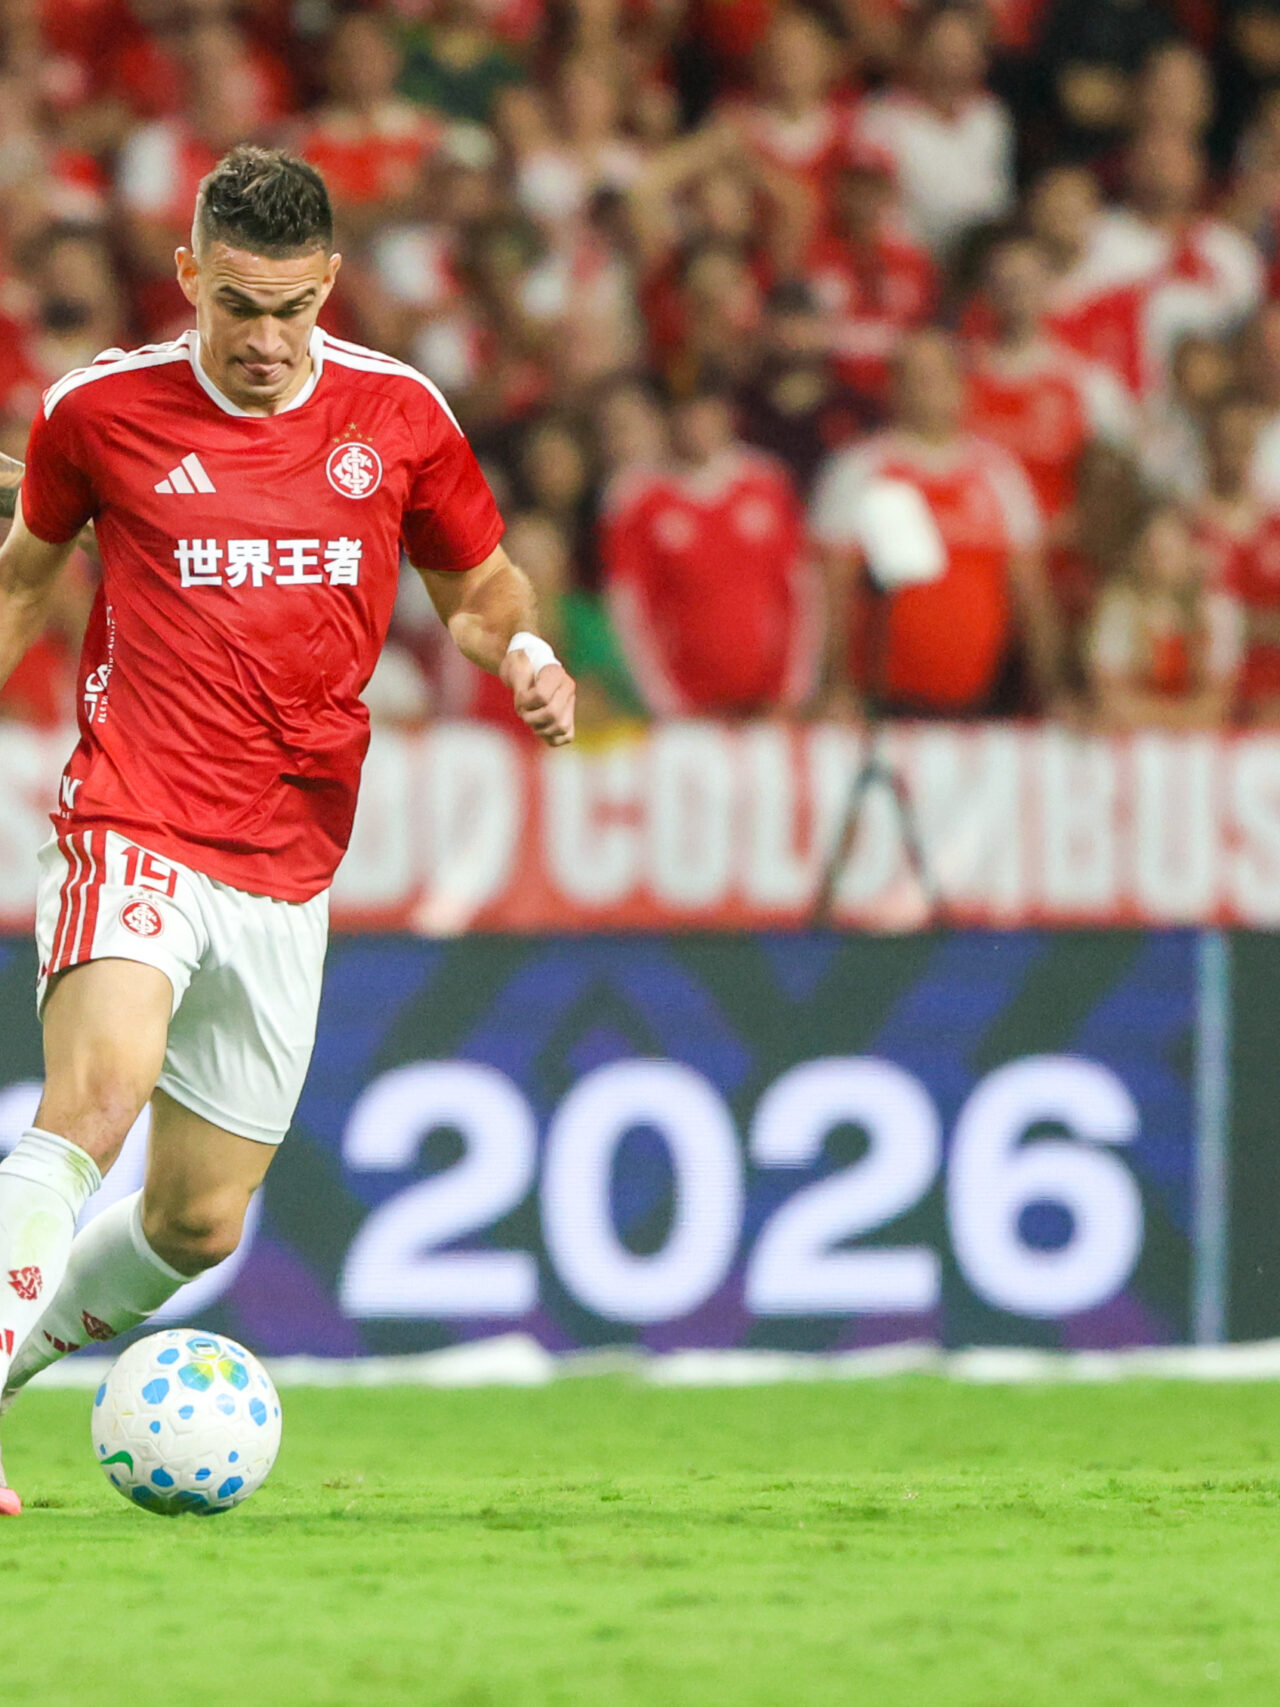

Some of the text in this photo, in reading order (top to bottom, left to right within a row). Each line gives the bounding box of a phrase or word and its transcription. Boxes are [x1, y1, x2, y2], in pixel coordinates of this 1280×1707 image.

[173, 536, 363, 588] 世界王者
[120, 845, 178, 899] 19
[339, 1053, 1145, 1323] 2026
